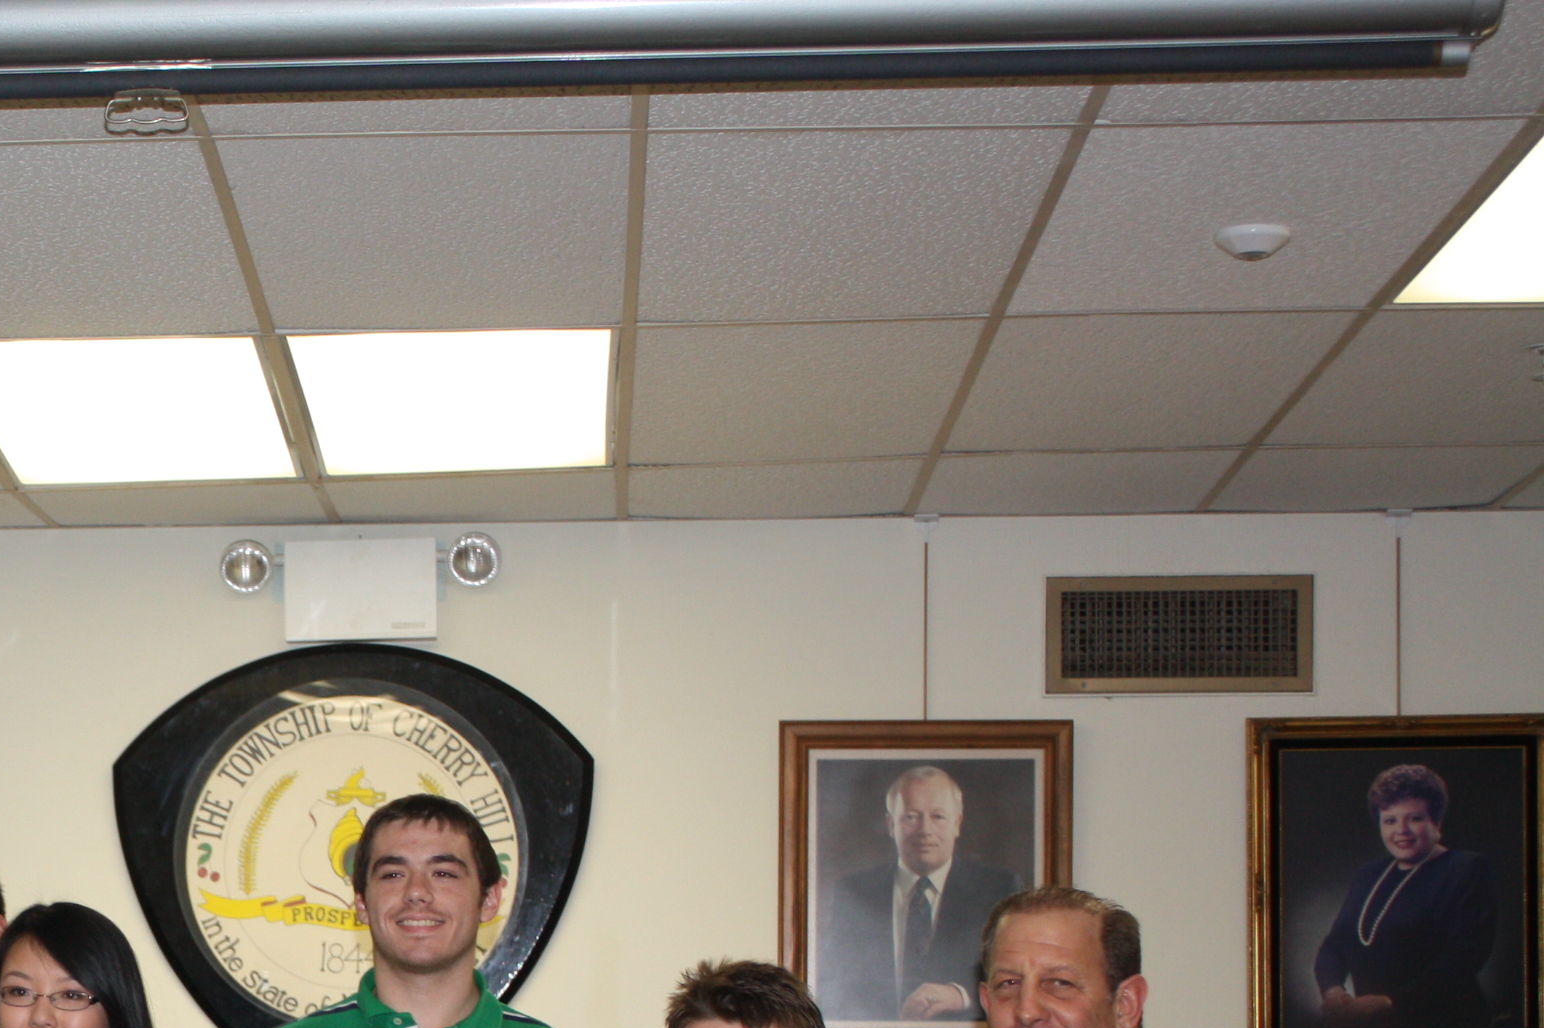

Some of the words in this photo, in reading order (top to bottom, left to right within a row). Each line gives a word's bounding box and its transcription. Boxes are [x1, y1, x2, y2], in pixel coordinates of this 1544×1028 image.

[191, 790, 234, 840] THE
[217, 701, 336, 788] TOWNSHIP
[349, 700, 383, 732] OF
[392, 708, 489, 787] CHERRY
[200, 915, 223, 940] in
[213, 935, 244, 973] the
